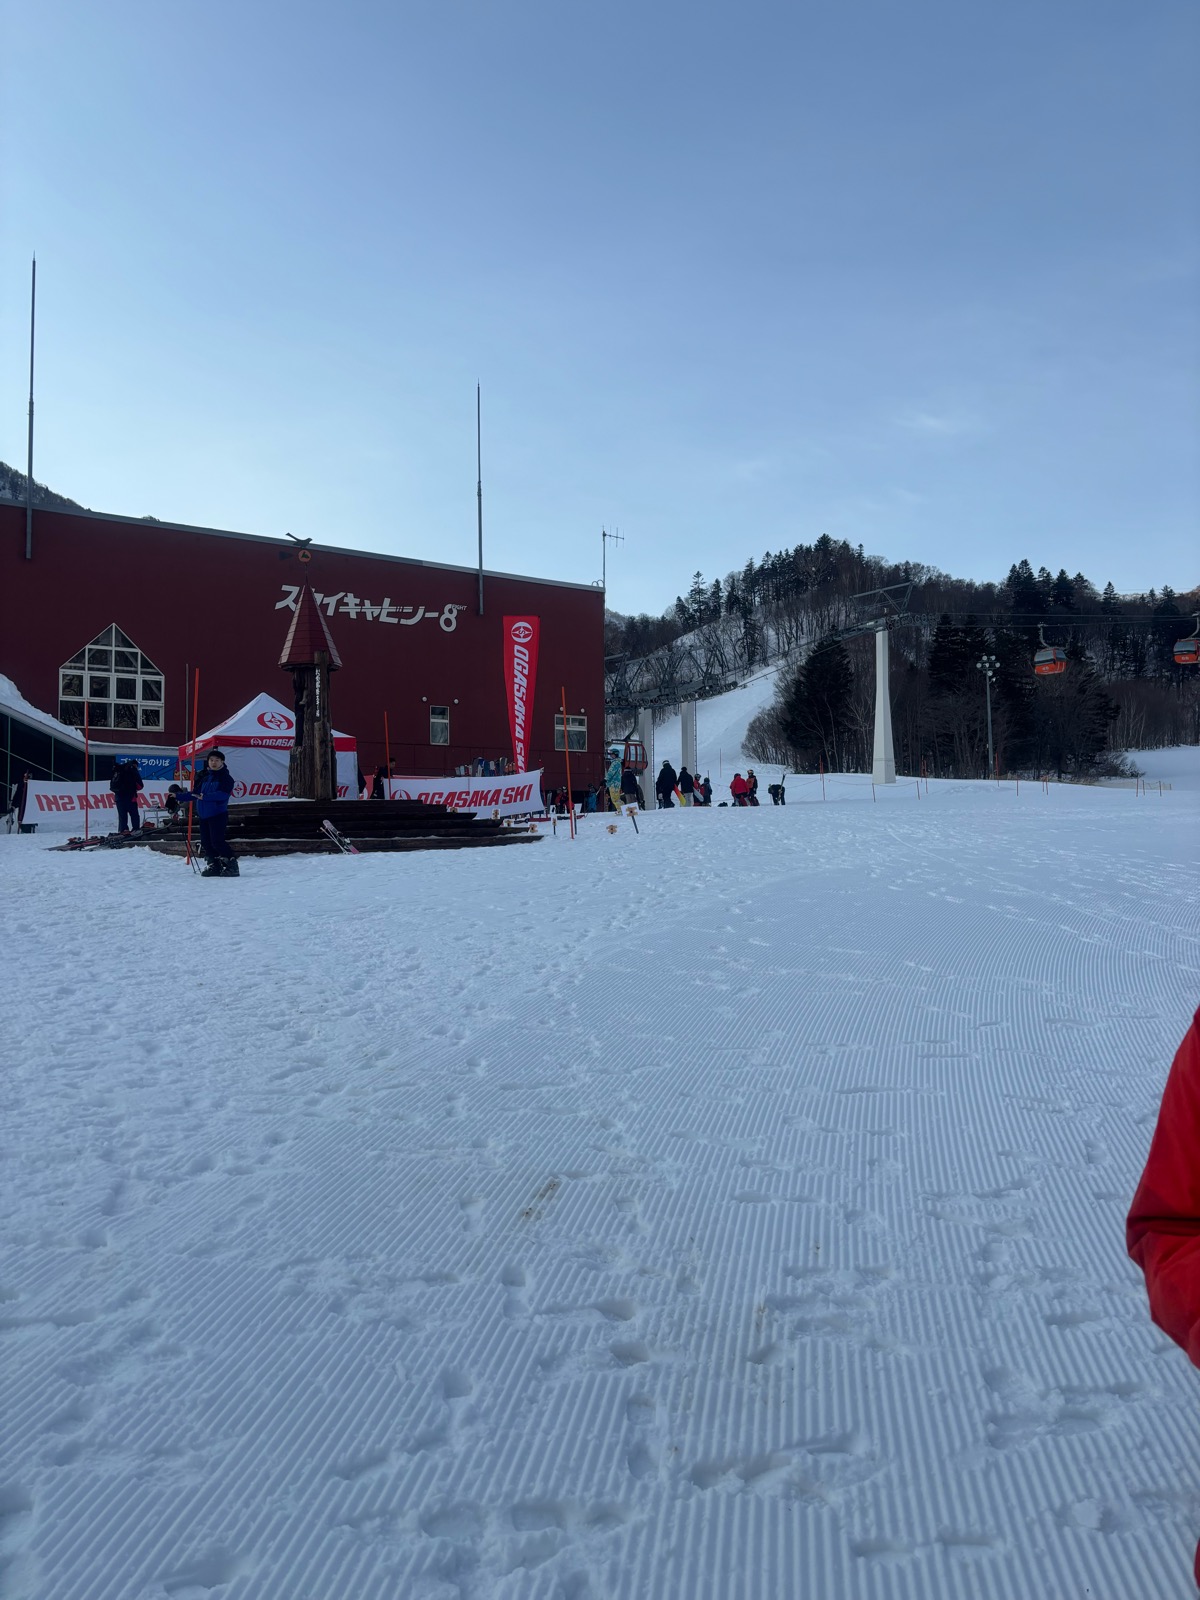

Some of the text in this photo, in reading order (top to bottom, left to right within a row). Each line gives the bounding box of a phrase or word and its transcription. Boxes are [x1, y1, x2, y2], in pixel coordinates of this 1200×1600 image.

[513, 644, 529, 740] OGASAKA
[262, 738, 295, 747] OGASA
[248, 783, 289, 797] OGAS
[416, 783, 534, 808] OGASAKA SKI
